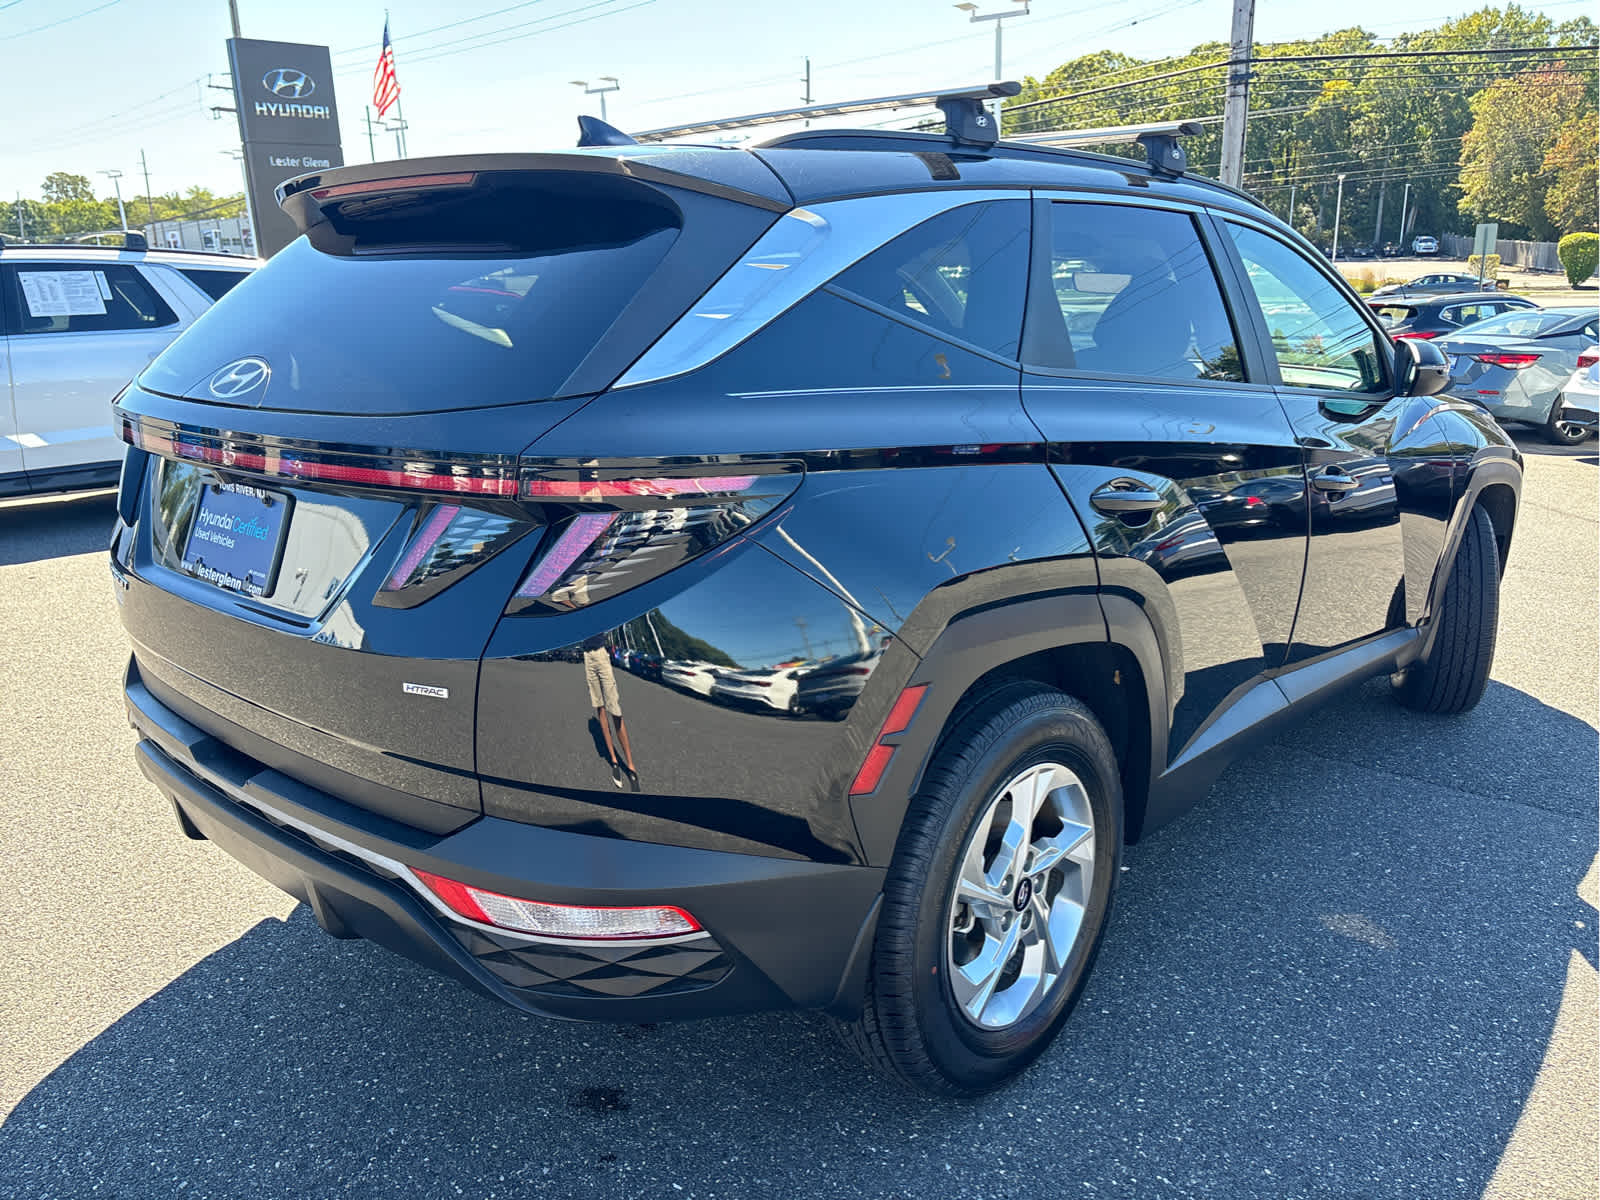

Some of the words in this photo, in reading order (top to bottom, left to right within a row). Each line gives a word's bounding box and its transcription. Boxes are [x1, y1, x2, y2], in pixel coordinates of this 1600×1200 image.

[255, 101, 330, 119] HYUNDAI
[269, 156, 300, 167] Lester
[302, 157, 330, 168] Glenn
[256, 488, 266, 499] NJ
[199, 507, 235, 531] Hyundai
[232, 517, 270, 541] Certified
[195, 527, 209, 540] Used
[209, 529, 236, 548] Vehicles
[197, 563, 242, 590] lesterglenn
[406, 684, 444, 696] HTRAC
